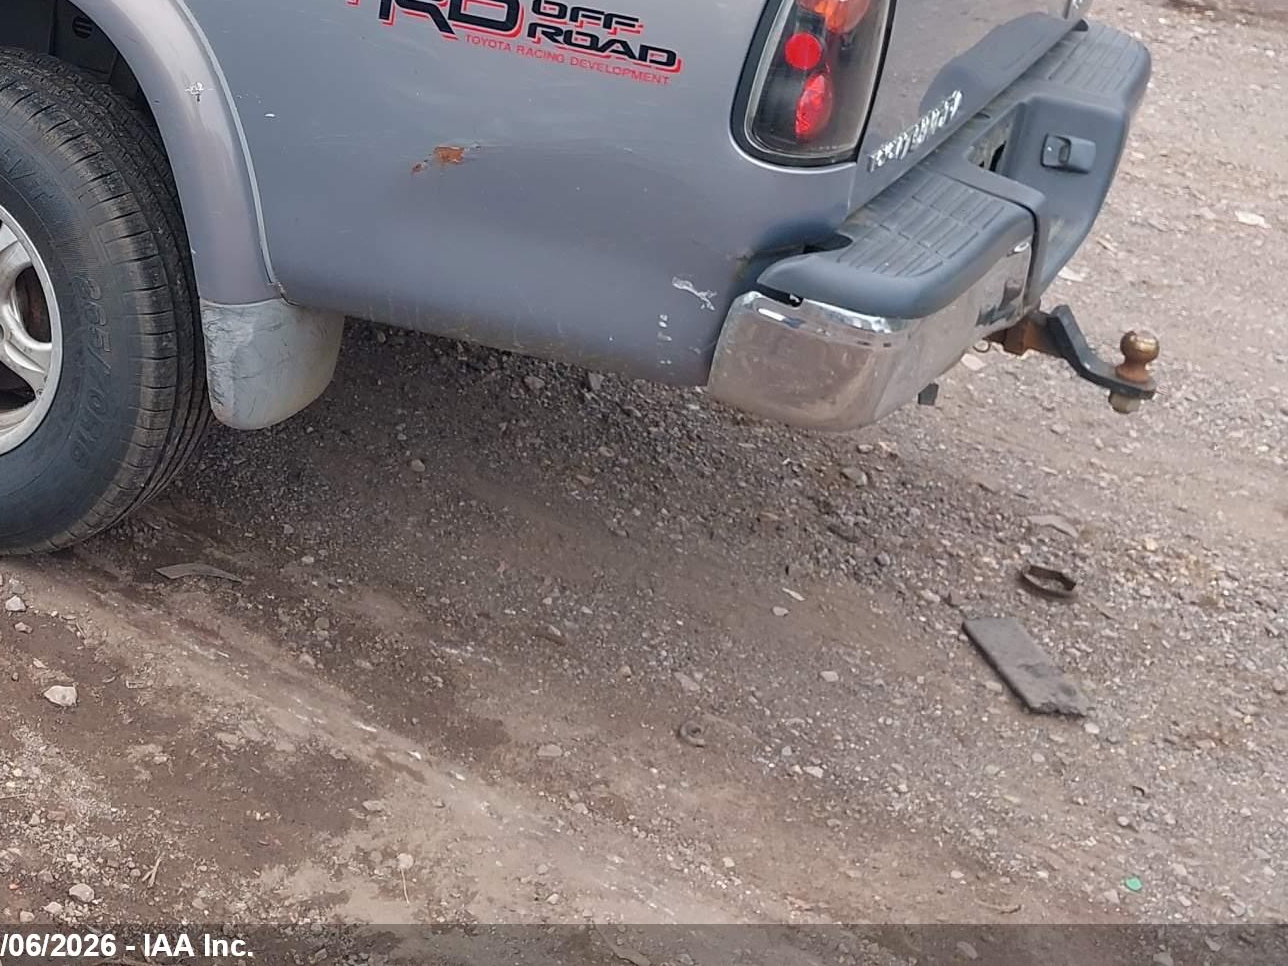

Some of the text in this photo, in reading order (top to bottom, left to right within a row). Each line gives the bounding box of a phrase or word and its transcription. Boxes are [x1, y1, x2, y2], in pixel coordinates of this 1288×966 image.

[465, 33, 671, 85] TOYOTA RACING DEVELOPMENT
[527, 22, 682, 74] ROAD
